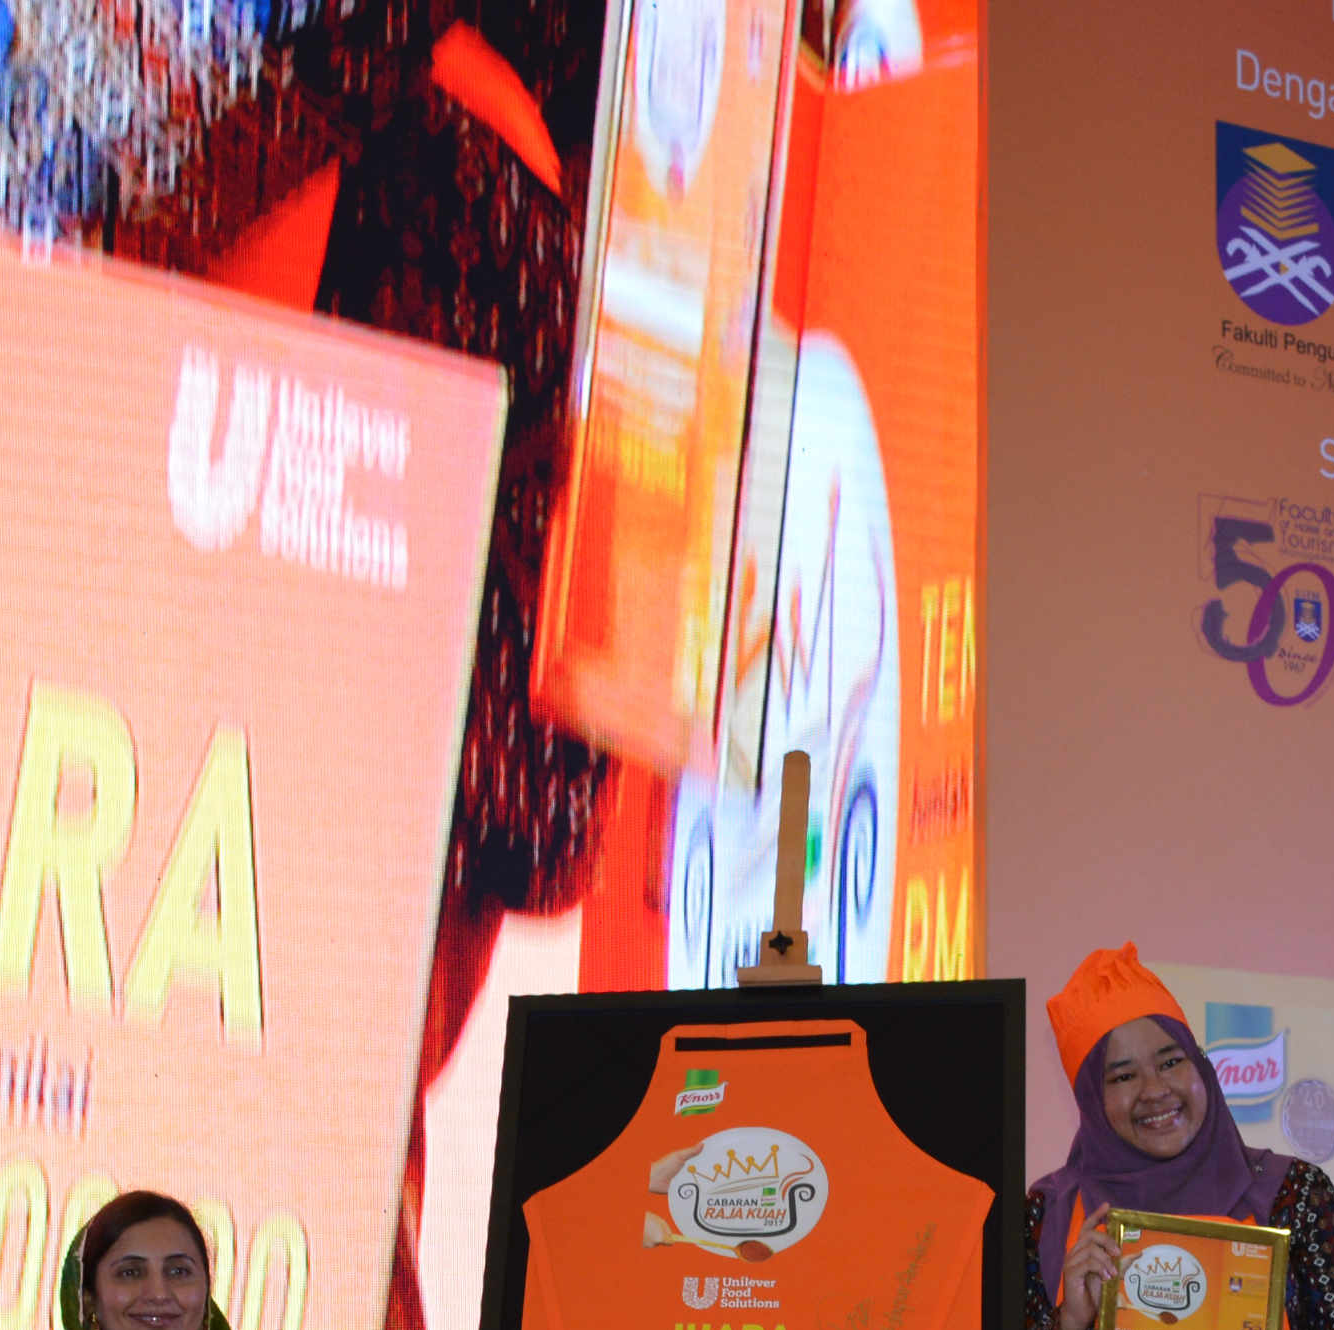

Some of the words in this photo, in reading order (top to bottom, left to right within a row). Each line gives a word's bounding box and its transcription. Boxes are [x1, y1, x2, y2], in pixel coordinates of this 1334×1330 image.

[1221, 320, 1278, 349] Fakulti
[1293, 373, 1307, 388] to
[679, 1092, 722, 1106] Knorr
[706, 1198, 759, 1207] CABARAN
[704, 1207, 744, 1220] RAJA
[746, 1207, 788, 1220] KUAH
[722, 1276, 777, 1289] Unilever
[721, 1286, 752, 1298] Food
[720, 1296, 780, 1309] Solutions
